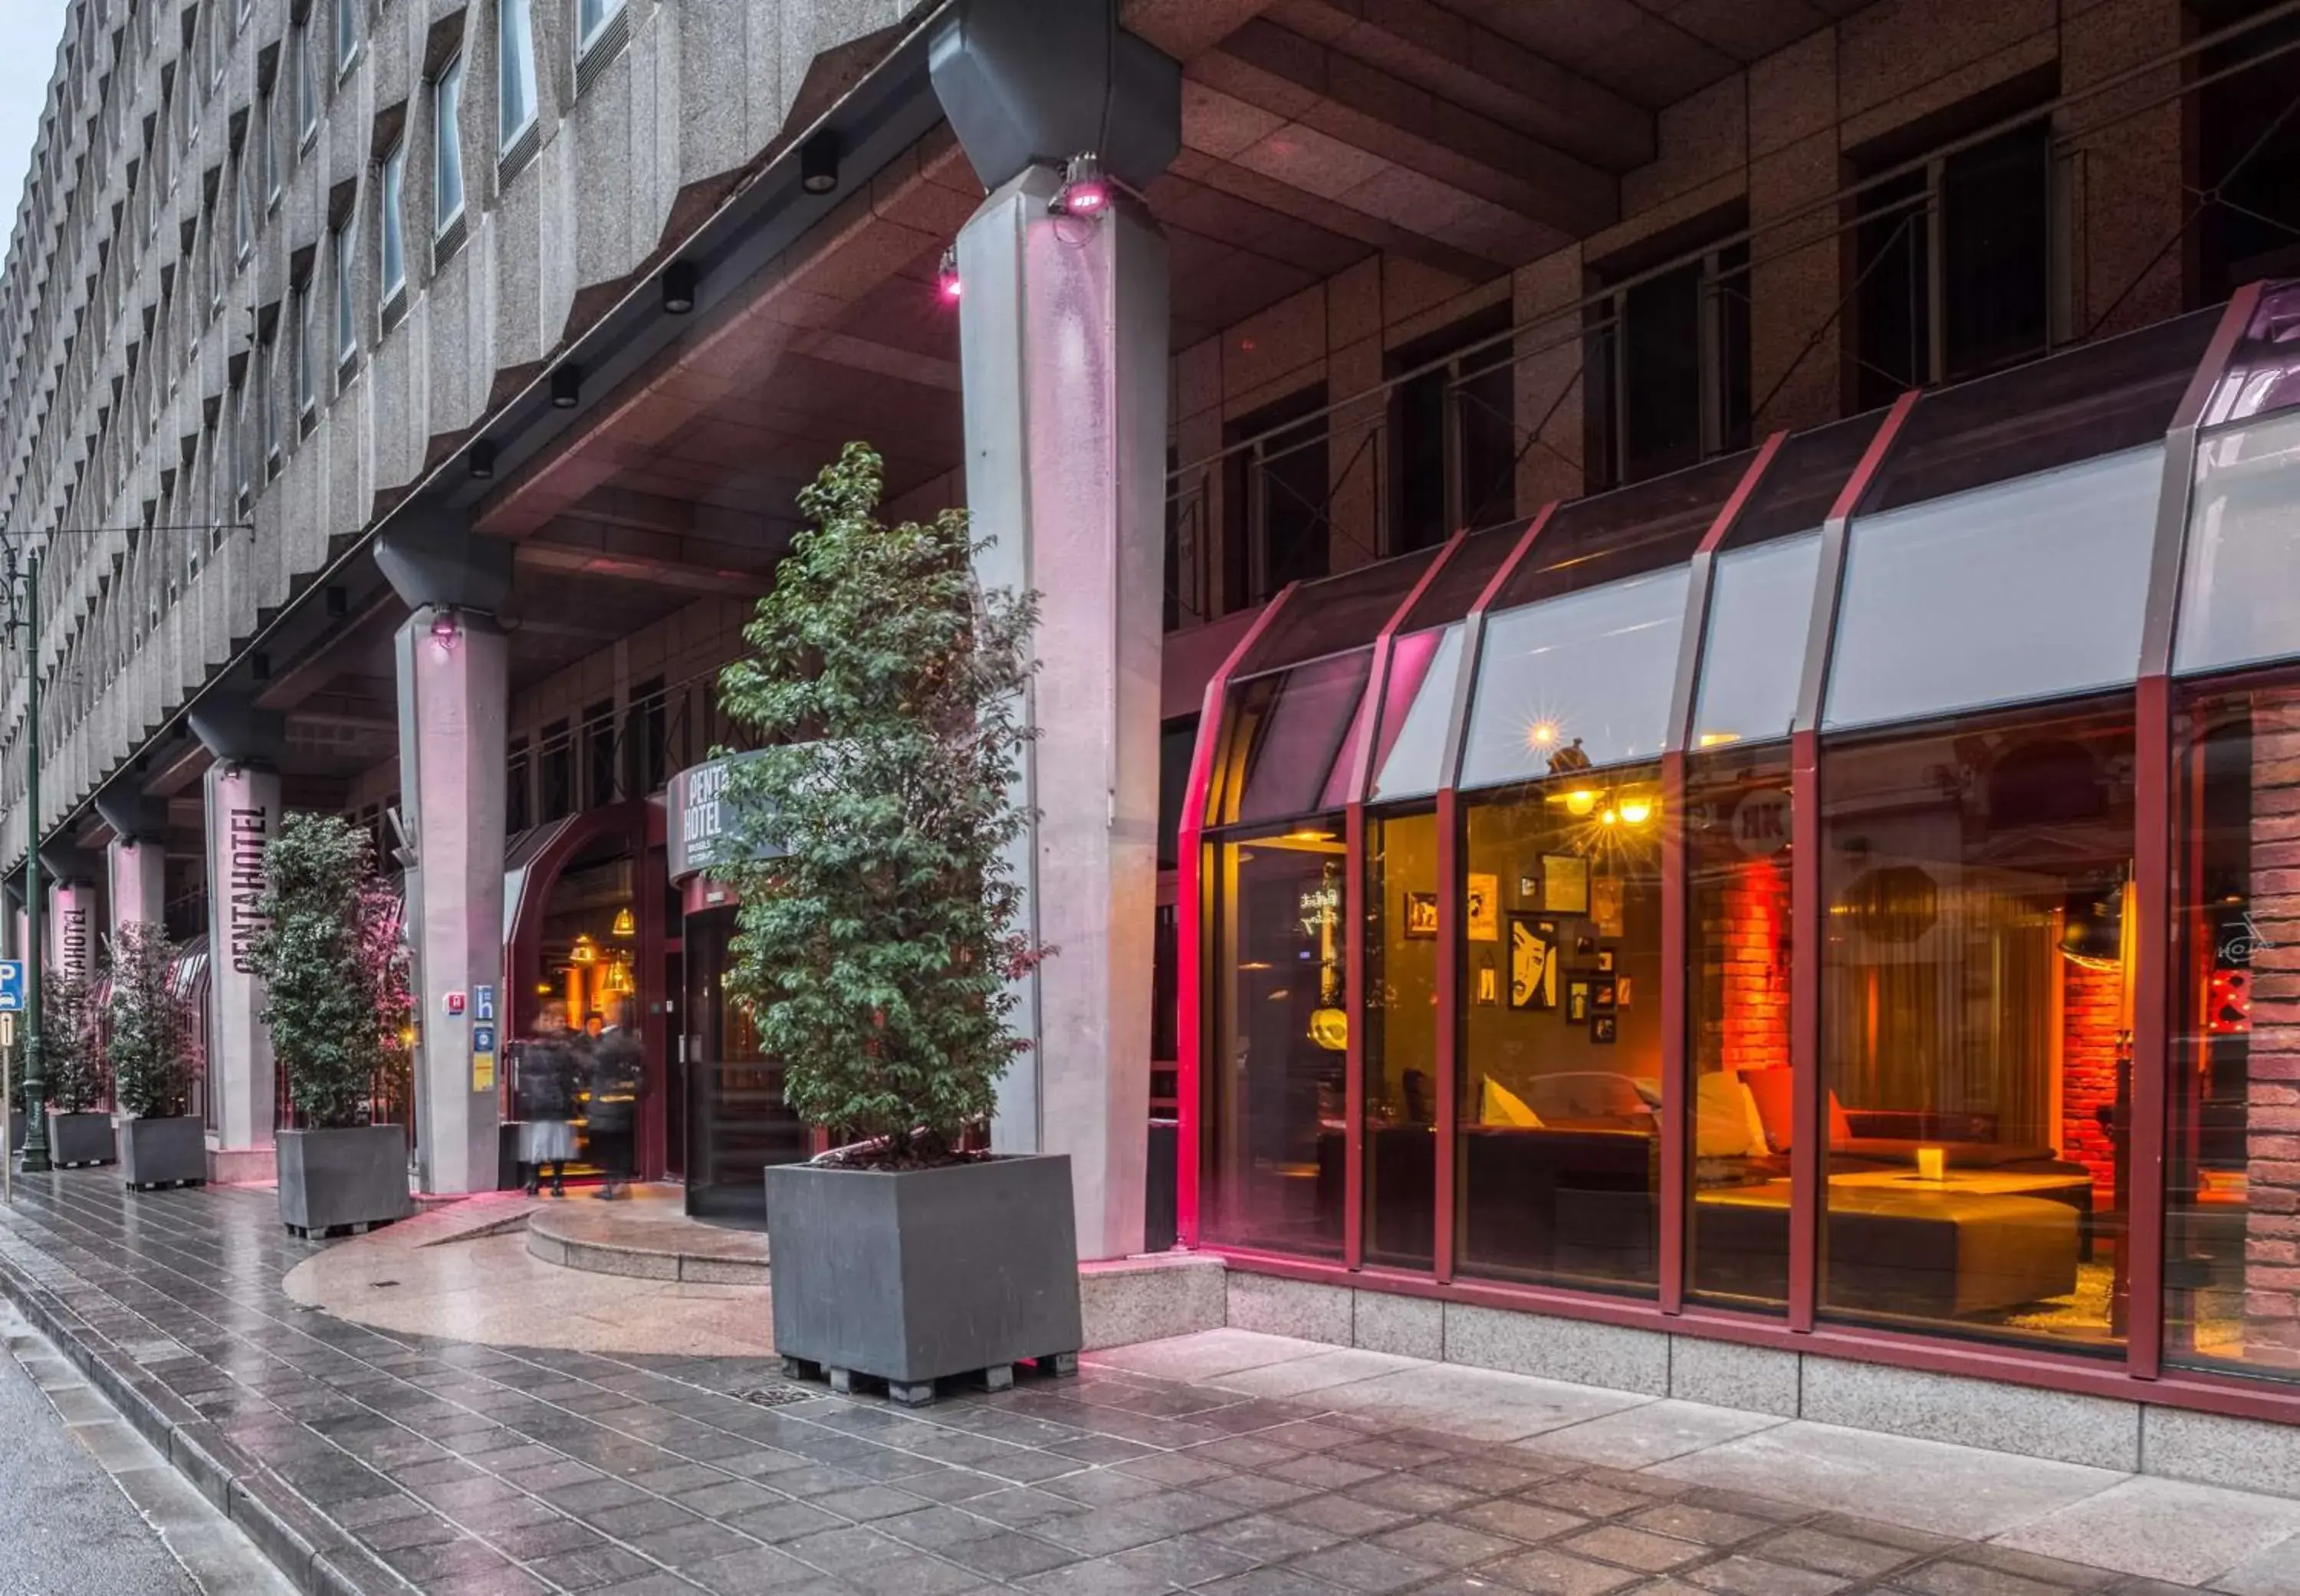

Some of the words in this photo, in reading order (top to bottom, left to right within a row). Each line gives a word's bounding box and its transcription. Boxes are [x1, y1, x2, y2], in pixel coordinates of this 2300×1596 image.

[685, 800, 721, 842] HOTEL
[64, 908, 86, 995] TAHOTEL
[0, 964, 16, 990] P
